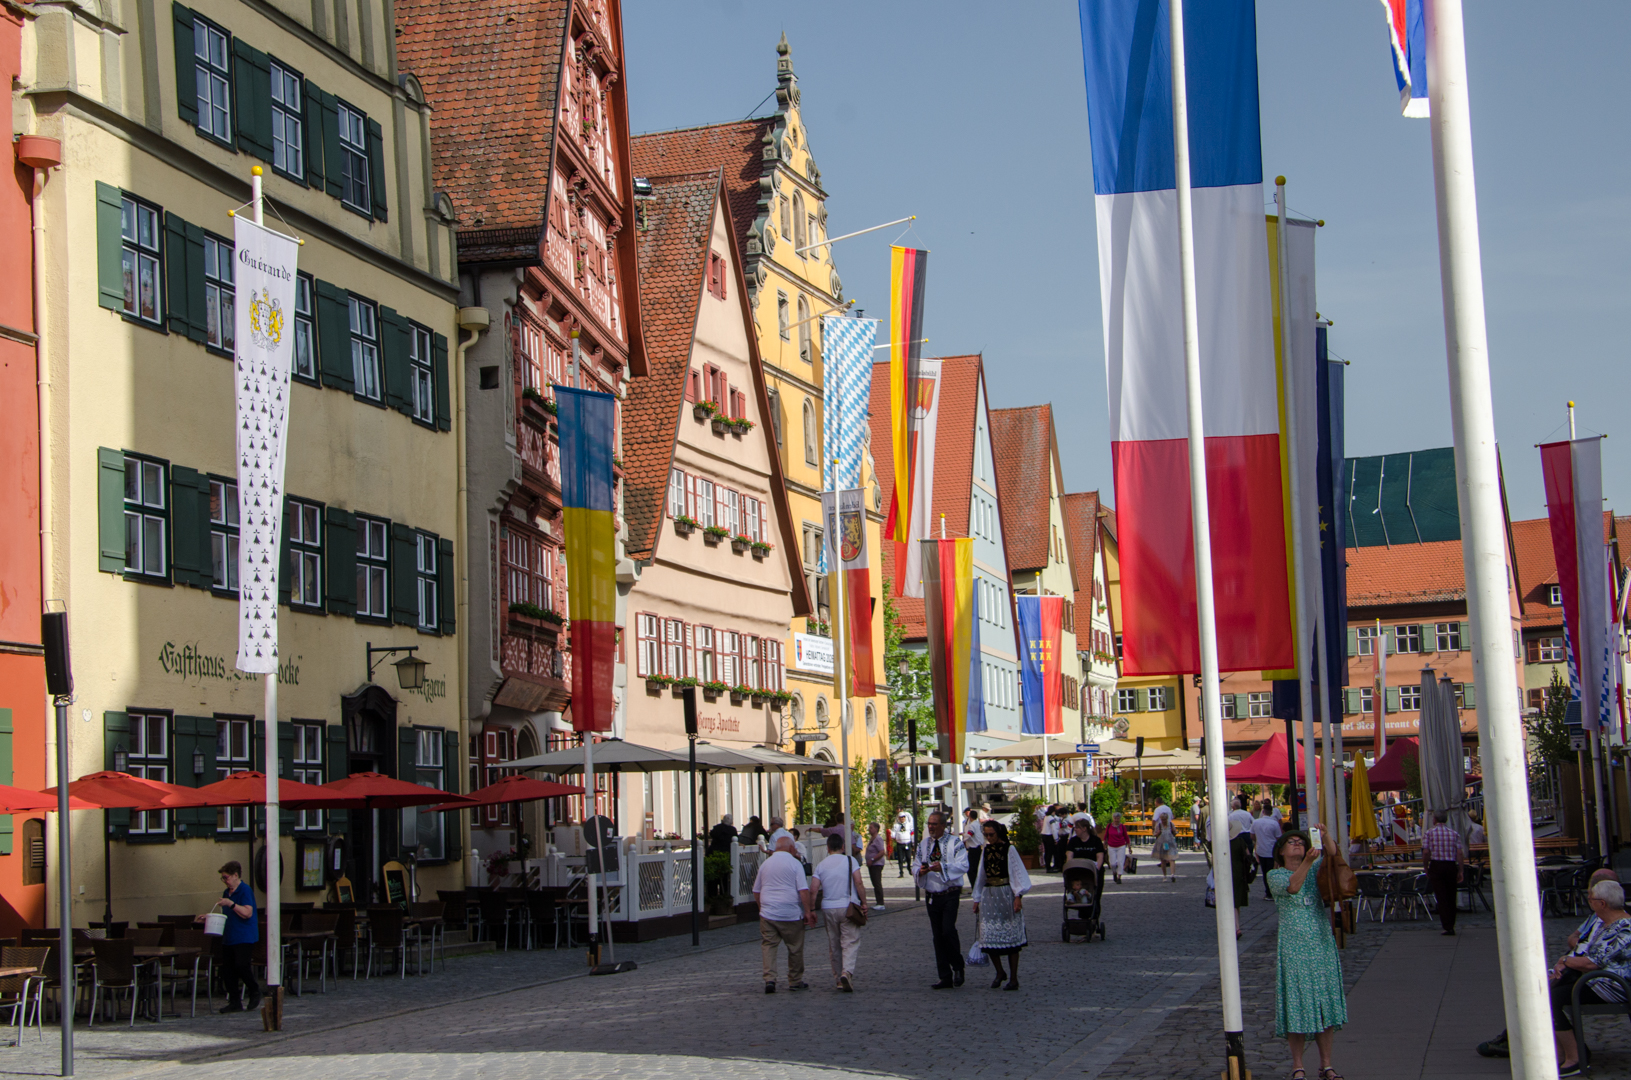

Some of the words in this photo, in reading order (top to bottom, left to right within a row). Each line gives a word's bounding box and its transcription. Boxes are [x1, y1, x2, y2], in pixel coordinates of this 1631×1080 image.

[239, 248, 291, 281] Guérande
[159, 640, 226, 683] Gasthaus
[1356, 720, 1410, 731] Resurant
